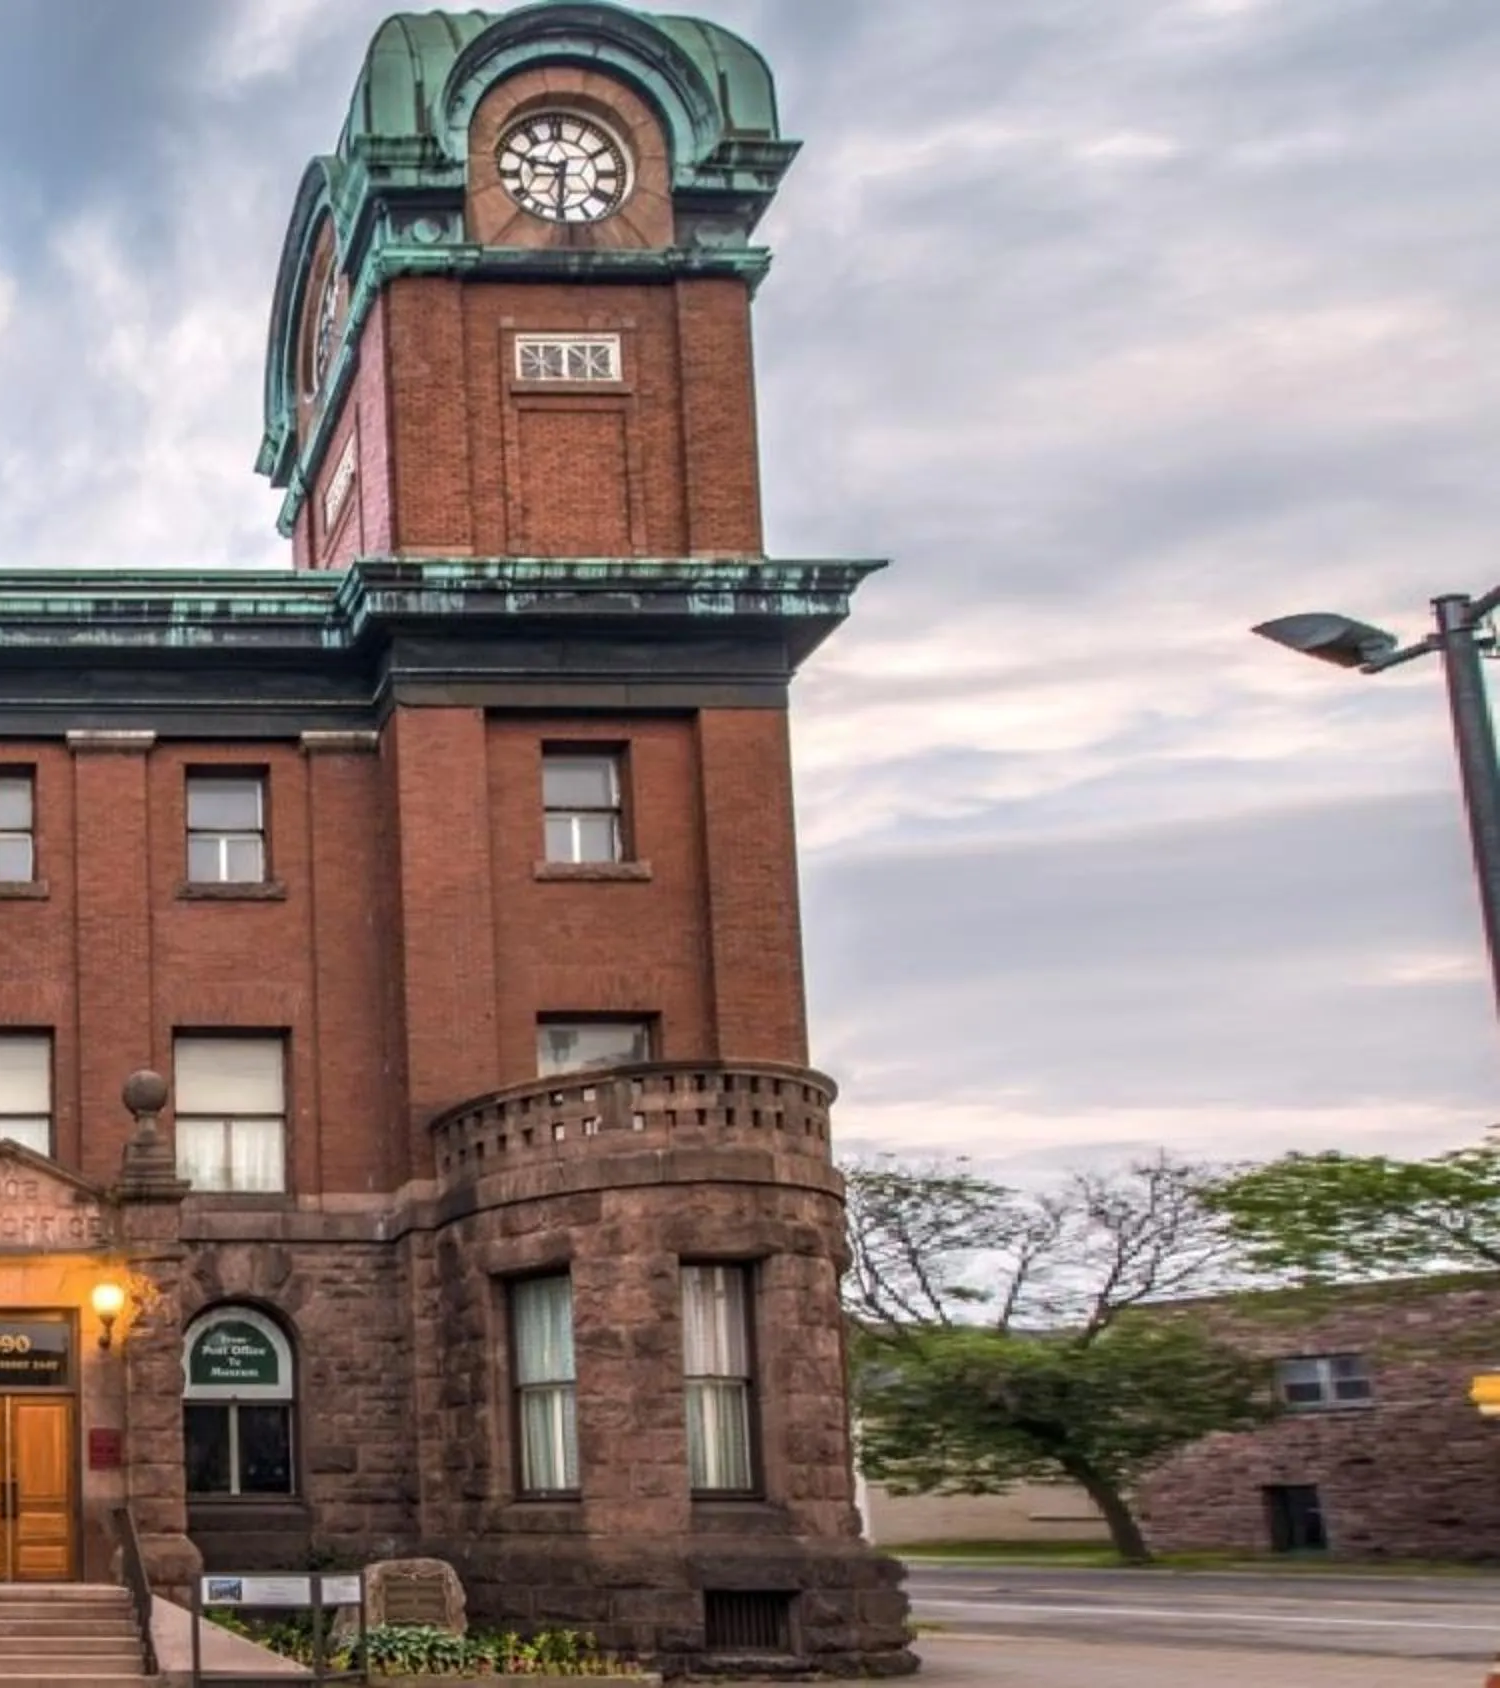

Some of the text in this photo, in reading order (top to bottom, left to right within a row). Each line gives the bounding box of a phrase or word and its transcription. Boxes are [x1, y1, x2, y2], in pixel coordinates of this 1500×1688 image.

[2, 1215, 102, 1238] OFFCE
[202, 1345, 266, 1356] Post Office
[228, 1357, 242, 1367] To
[210, 1366, 260, 1378] Museum
